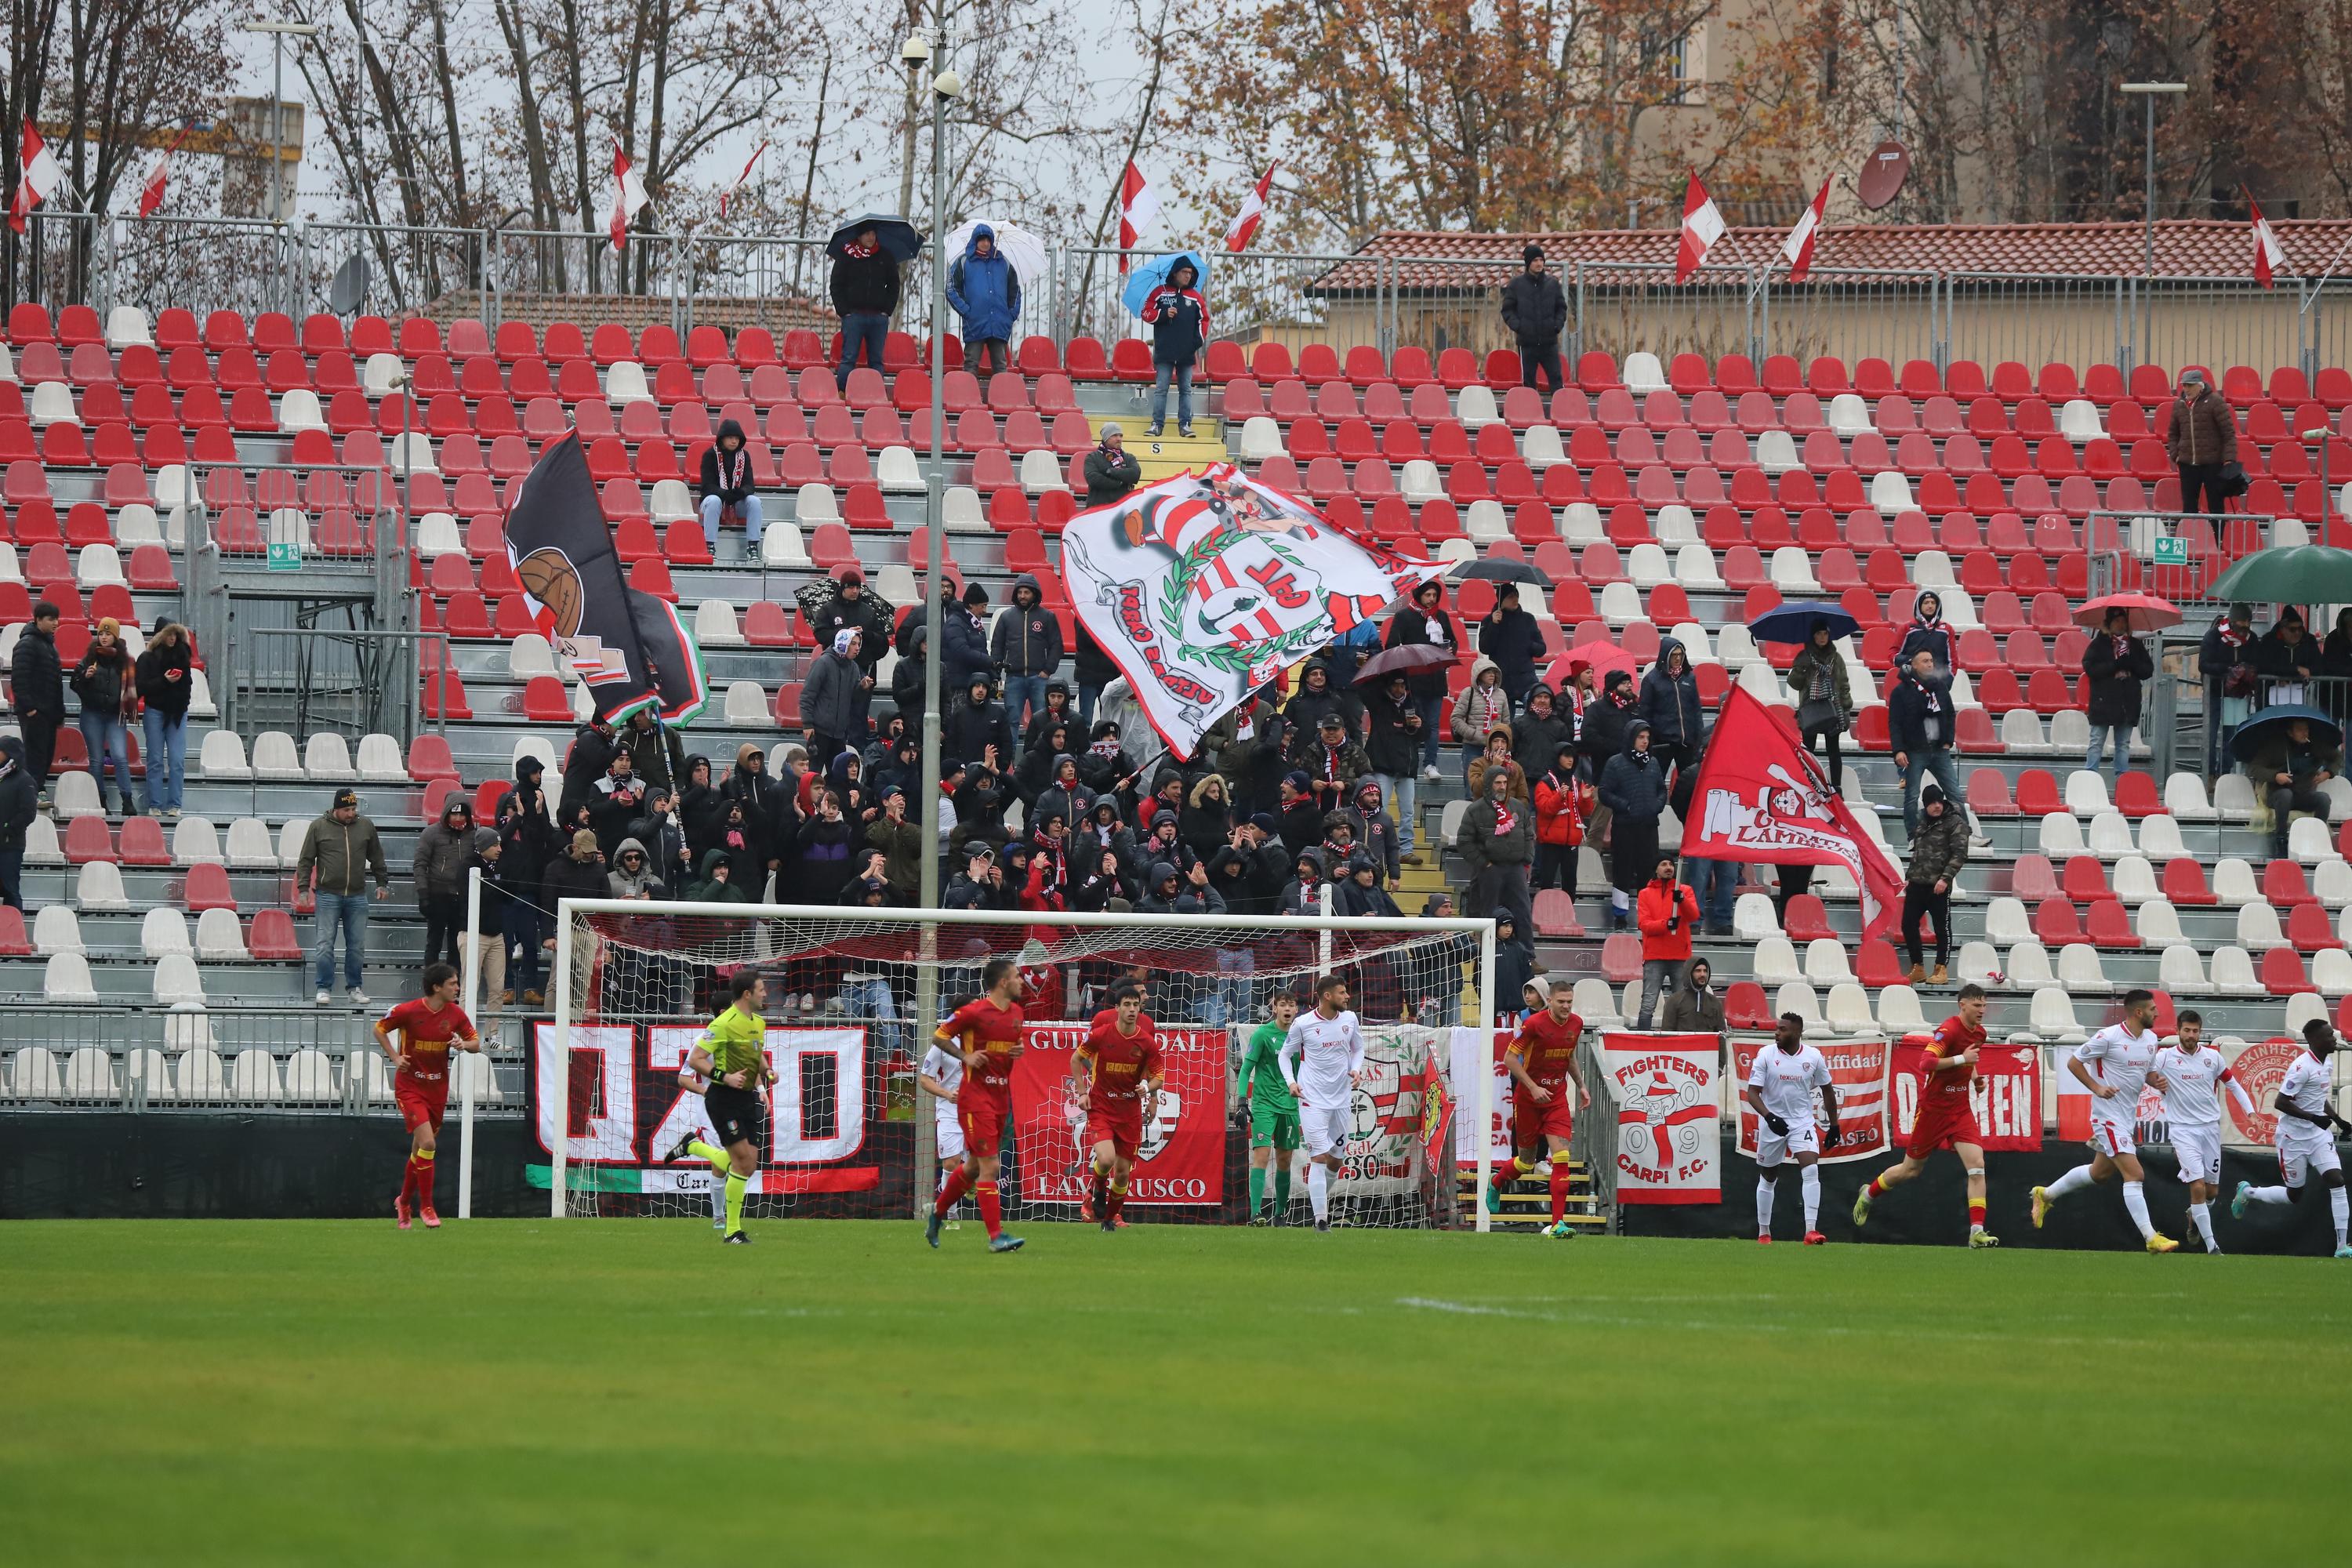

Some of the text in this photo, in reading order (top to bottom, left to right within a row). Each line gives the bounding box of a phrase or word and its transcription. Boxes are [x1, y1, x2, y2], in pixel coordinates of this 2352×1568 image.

[1137, 387, 1144, 397] T
[1152, 444, 1160, 453] S
[2238, 1044, 2299, 1071] SKINHEA
[1624, 1080, 1700, 1109] 2 0
[1336, 1134, 1345, 1147] 6
[1625, 1125, 1700, 1155] 0 9
[1804, 1130, 1813, 1142] 4
[2212, 1158, 2219, 1174] 5
[1038, 1176, 1206, 1199] LAMRUSCO
